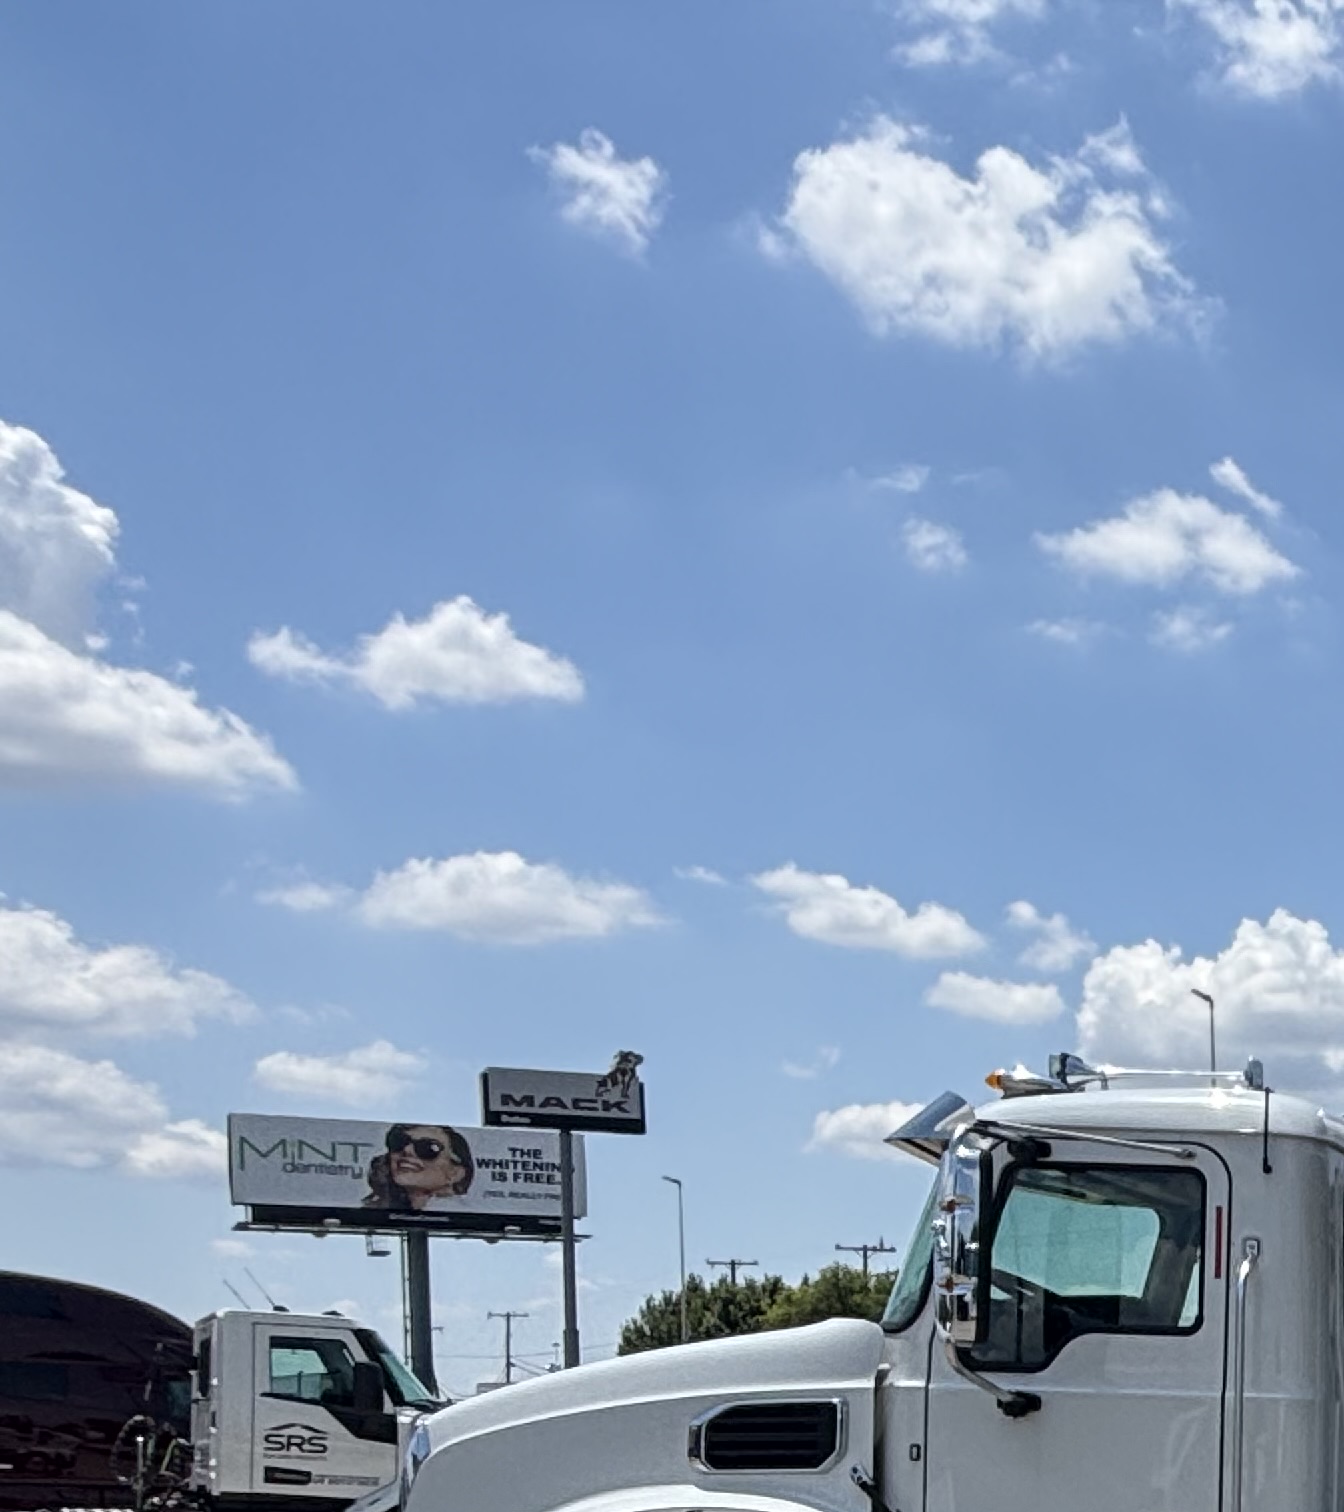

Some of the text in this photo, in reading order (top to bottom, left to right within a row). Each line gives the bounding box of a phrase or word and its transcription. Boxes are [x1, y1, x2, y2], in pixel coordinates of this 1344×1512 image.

[501, 1093, 631, 1114] MACK
[507, 1147, 543, 1160] THE
[475, 1158, 562, 1173] WHITENIN
[491, 1171, 508, 1182] IS
[263, 1434, 329, 1454] SRS
